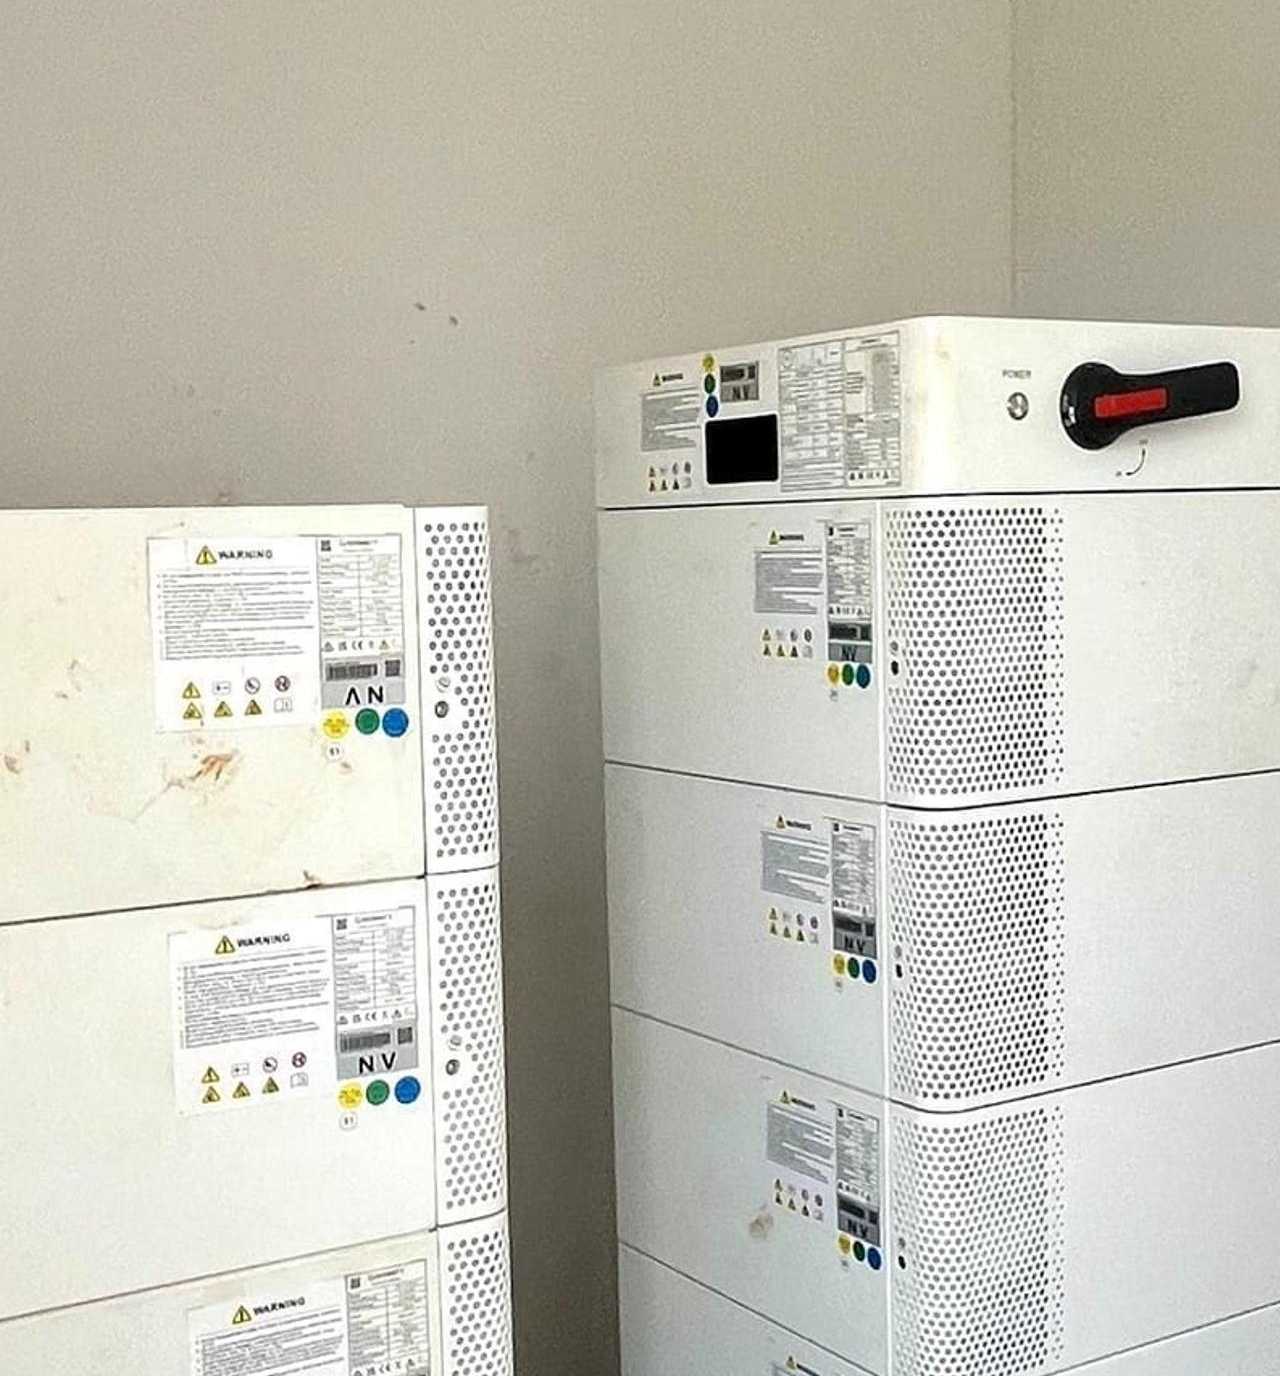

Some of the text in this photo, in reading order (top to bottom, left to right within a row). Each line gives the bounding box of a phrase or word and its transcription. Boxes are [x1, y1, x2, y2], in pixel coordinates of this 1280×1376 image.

[218, 549, 273, 560] WARNING
[237, 933, 291, 948] WARNING
[253, 1296, 306, 1316] WARNING
